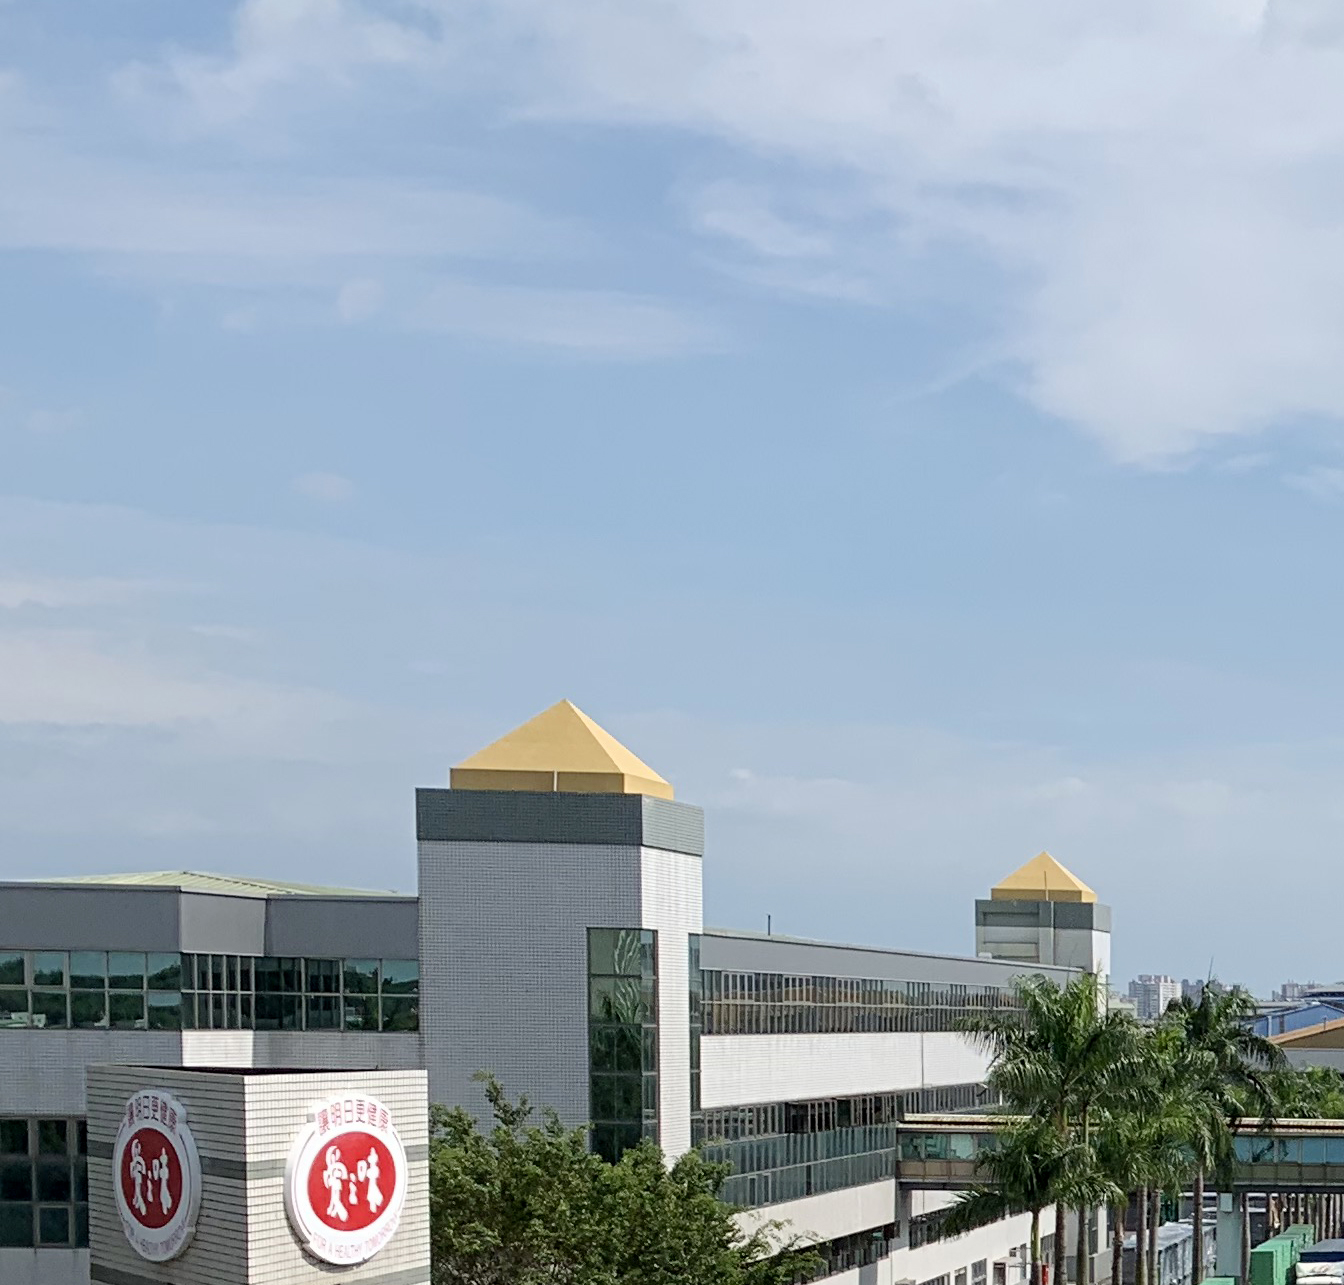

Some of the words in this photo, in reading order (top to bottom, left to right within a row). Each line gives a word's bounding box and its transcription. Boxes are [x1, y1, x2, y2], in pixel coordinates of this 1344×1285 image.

[317, 1099, 389, 1136] 讓明日更健康
[130, 1138, 172, 1216] 愛之味
[323, 1145, 384, 1222] 愛之味
